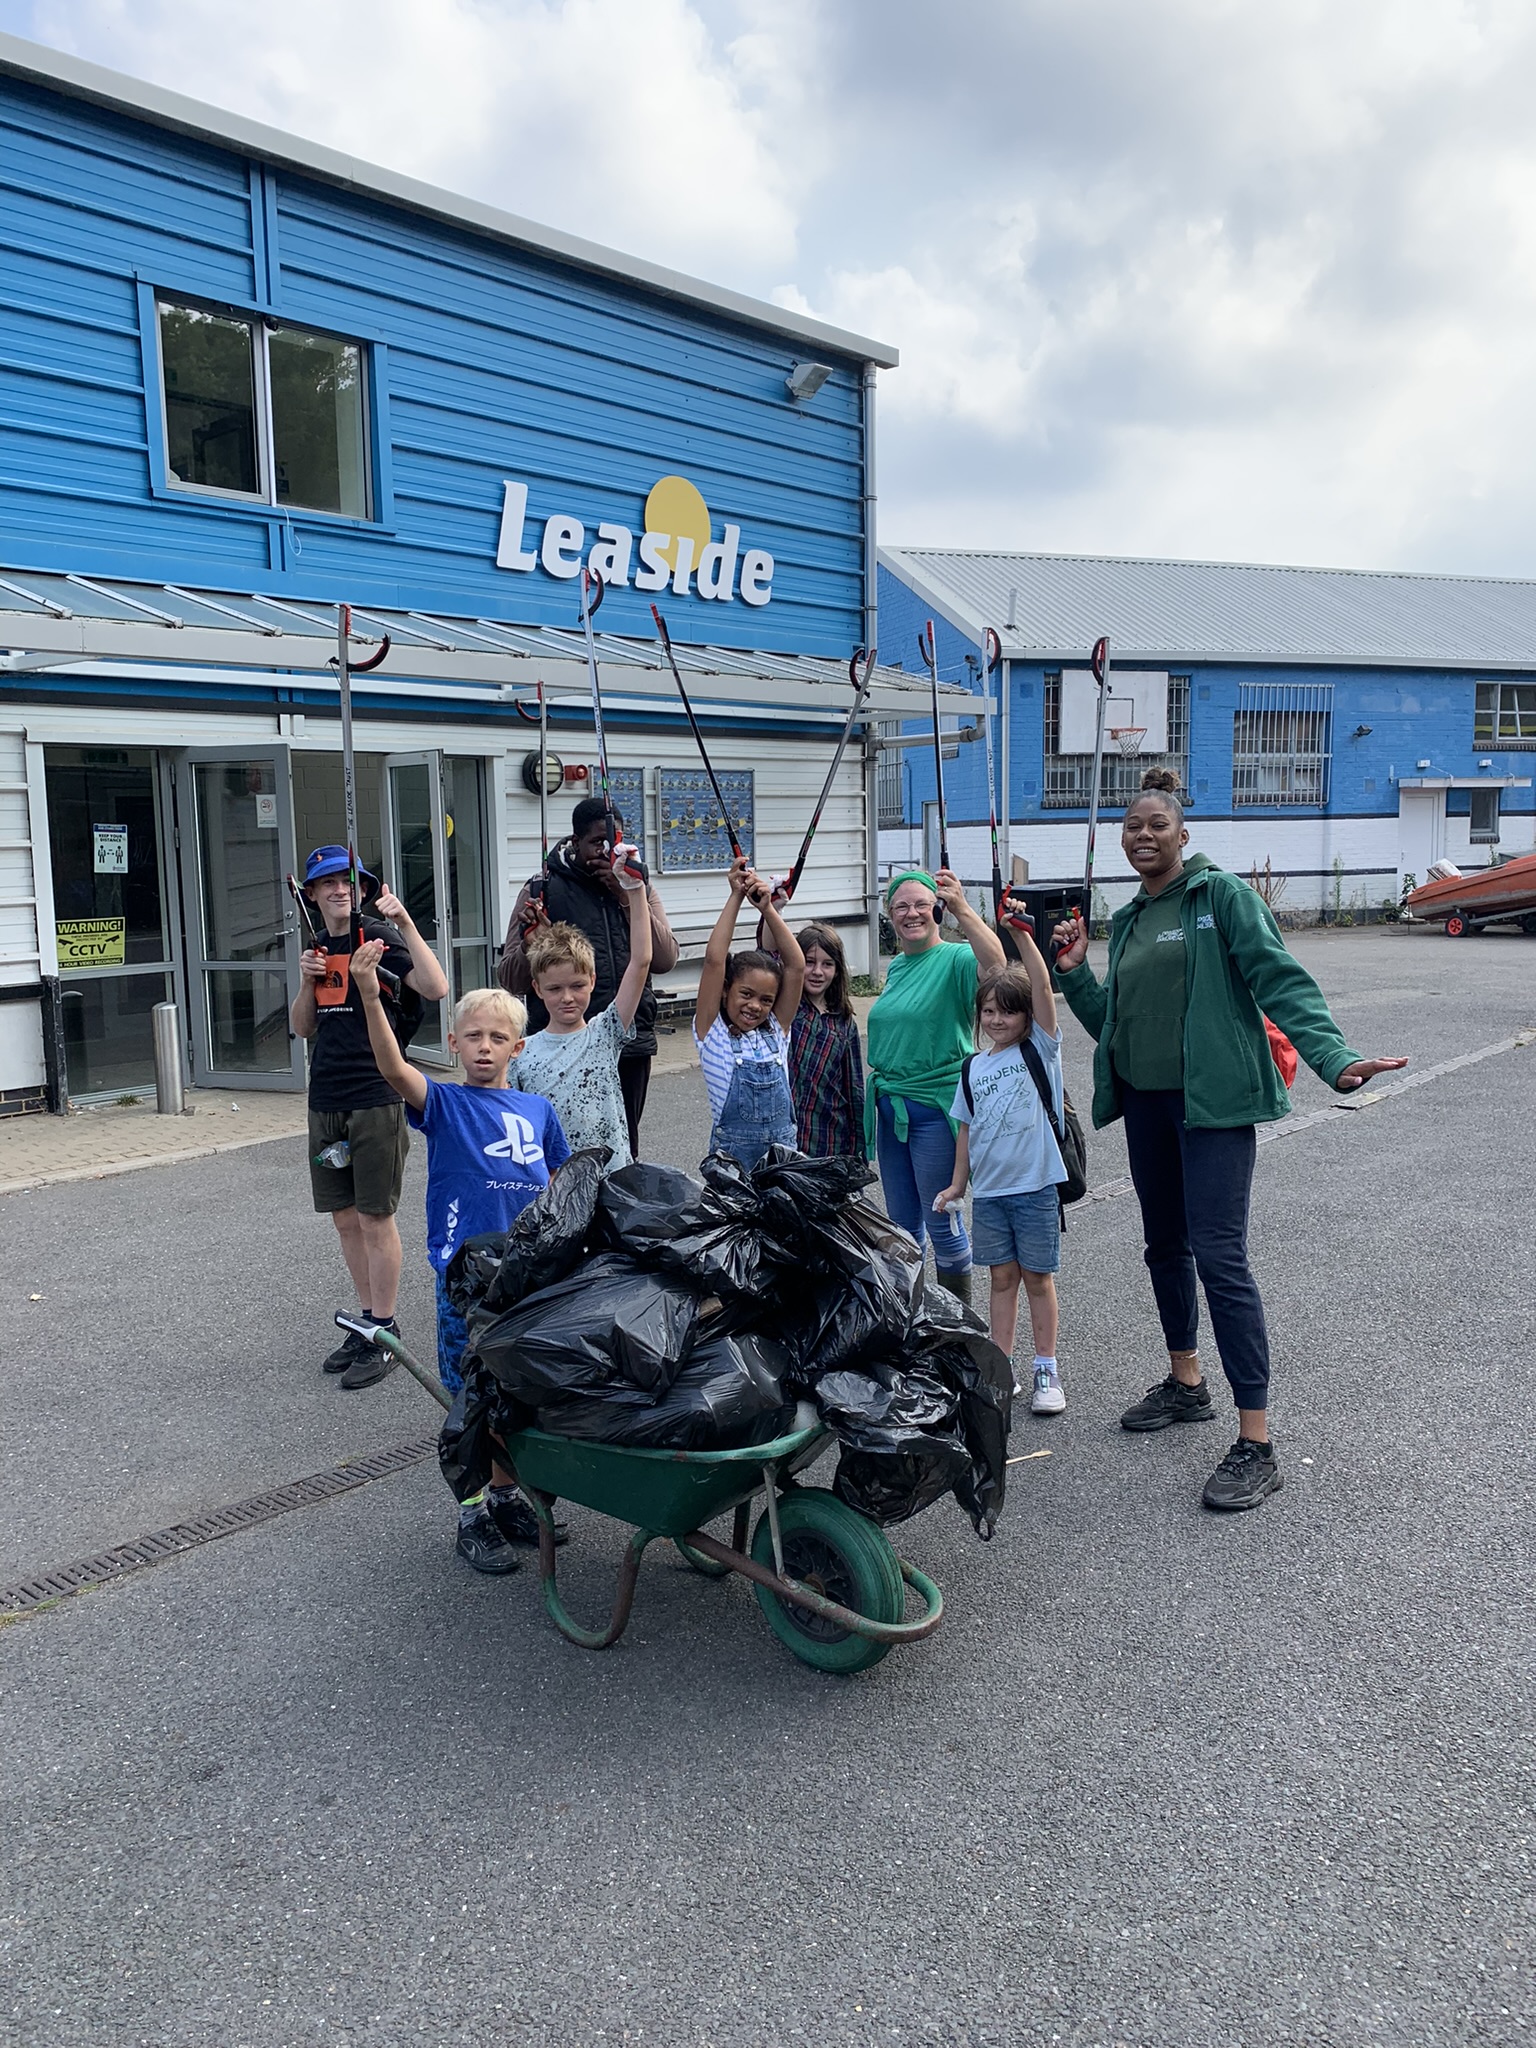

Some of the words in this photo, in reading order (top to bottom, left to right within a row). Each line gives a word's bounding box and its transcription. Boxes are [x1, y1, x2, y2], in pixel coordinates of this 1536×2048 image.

[496, 480, 774, 606] Leaside
[57, 920, 121, 934] WARNING!
[69, 943, 107, 957] CCTV
[485, 1180, 547, 1192] プレイステーション
